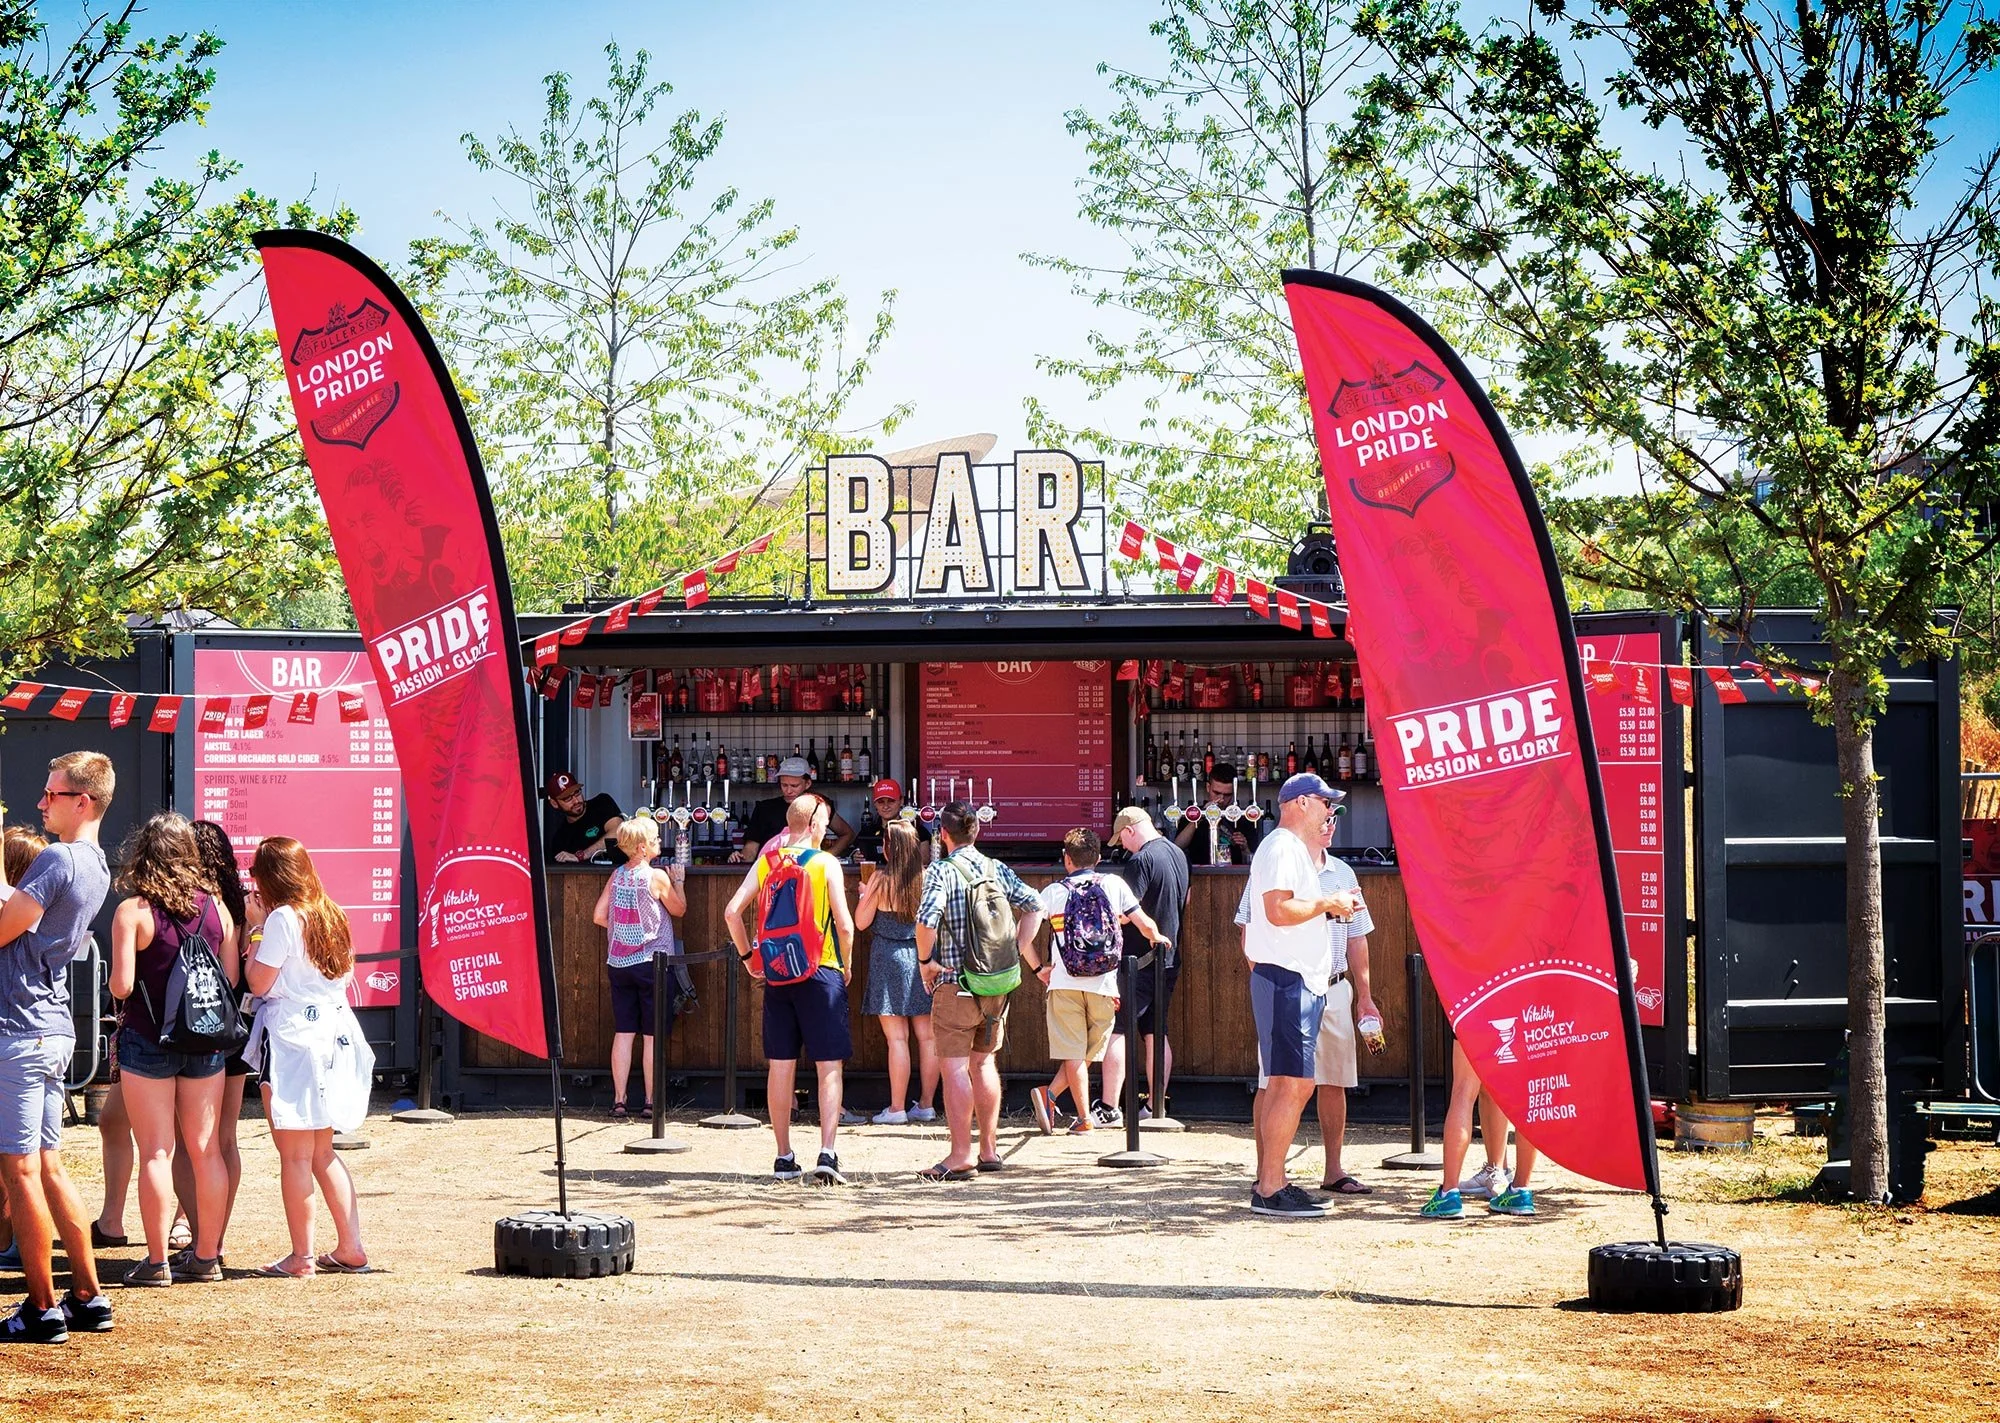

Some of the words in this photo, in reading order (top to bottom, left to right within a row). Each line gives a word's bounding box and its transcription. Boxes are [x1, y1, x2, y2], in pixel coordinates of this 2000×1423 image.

[296, 331, 394, 393] LONDON
[313, 360, 385, 409] PRIDE
[332, 406, 367, 436] ORIGINAL
[366, 393, 380, 410] ALE
[1335, 399, 1449, 448] LONDON
[1356, 427, 1438, 468] PRIDE
[1378, 469, 1414, 499] ORIGINAL
[1414, 460, 1432, 474] ALE
[826, 450, 1091, 593] BAR
[685, 582, 706, 598] PRIDE
[376, 593, 490, 682] PRIDE
[536, 644, 557, 658] PRIDE
[272, 657, 321, 688] BAR
[391, 662, 444, 699] PASSION
[1670, 677, 1690, 687] LONDON
[1673, 682, 1688, 691] PRIDE
[10, 691, 35, 700] PRIDE
[60, 698, 82, 706] LONDON
[341, 697, 364, 708] LONDON
[247, 705, 268, 713] LONDON
[1619, 707, 1635, 717] £5.50
[1639, 707, 1655, 716] £3.00
[203, 711, 226, 719] PRIDE
[1394, 687, 1562, 765] PRIDE
[1619, 720, 1636, 730] £5.50
[1639, 720, 1655, 729] £3.00
[241, 729, 264, 739] LAGER
[265, 730, 284, 739] 4.5%
[350, 730, 370, 739] £5.50
[1620, 733, 1636, 743] £5.50
[1639, 733, 1655, 743] £3.00
[204, 741, 232, 751] AMSTEL
[232, 742, 251, 751] 4.1%
[350, 742, 370, 751] £5.50
[1620, 746, 1636, 756] £5.50
[1640, 746, 1656, 756] £3.00
[204, 754, 236, 764] CORNISH
[237, 754, 276, 764] ORCHARDS
[277, 754, 297, 764] GOLD
[297, 754, 320, 764] CIDER
[321, 754, 339, 764] 4.5%
[350, 754, 370, 764] £5.50
[374, 754, 394, 764] £3.00
[1405, 753, 1481, 785] PASSION
[1498, 734, 1560, 765] GLORY
[204, 774, 238, 785] SPIRITS,
[240, 774, 260, 785] WINE
[261, 774, 268, 785] &
[269, 774, 287, 785] FIZZ
[204, 787, 228, 797] SPIRIT
[230, 787, 248, 797] 25ml
[373, 787, 393, 797] £3.00
[1639, 783, 1656, 793] £3.00
[204, 799, 228, 809] SPIRIT
[230, 799, 248, 809] 50ml
[1640, 796, 1656, 806] £6.00
[204, 811, 224, 821] WINE
[225, 812, 247, 821] 125ml
[1640, 810, 1656, 819] £5.00
[225, 824, 247, 833] 175ml
[1640, 823, 1657, 833] £6.00
[1640, 836, 1657, 846] £6.00
[372, 867, 392, 877] £2.00
[1641, 872, 1657, 882] £2.00
[372, 879, 392, 889] £2.50
[372, 891, 392, 901] £2.00
[1641, 886, 1657, 896] £2.50
[443, 888, 480, 908] Vitality
[1641, 899, 1657, 909] £2.00
[372, 913, 392, 922] £1.00
[443, 903, 505, 926] HOCKEY
[445, 919, 486, 935] WOMEN'S
[487, 914, 516, 927] WORLD
[516, 911, 528, 921] CUP
[1642, 922, 1658, 932] £1.00
[446, 932, 471, 942] LONDON
[449, 951, 503, 973] OFFICIAL
[452, 969, 483, 988] BEER
[454, 980, 509, 1001] SPONSOR
[1522, 1003, 1555, 1024] Vitality
[191, 1022, 225, 1035] adidas
[1523, 1021, 1575, 1043] HOCKEY
[1526, 1039, 1559, 1053] WOMEN'S
[1559, 1034, 1588, 1046] WORLD
[1590, 1031, 1610, 1041] CUP
[1527, 1052, 1546, 1061] LONDON
[1546, 1049, 1558, 1057] 2018
[1527, 1073, 1571, 1094] OFFICIAL
[1528, 1092, 1553, 1109] BEER
[1526, 1103, 1577, 1124] SPONSOR
